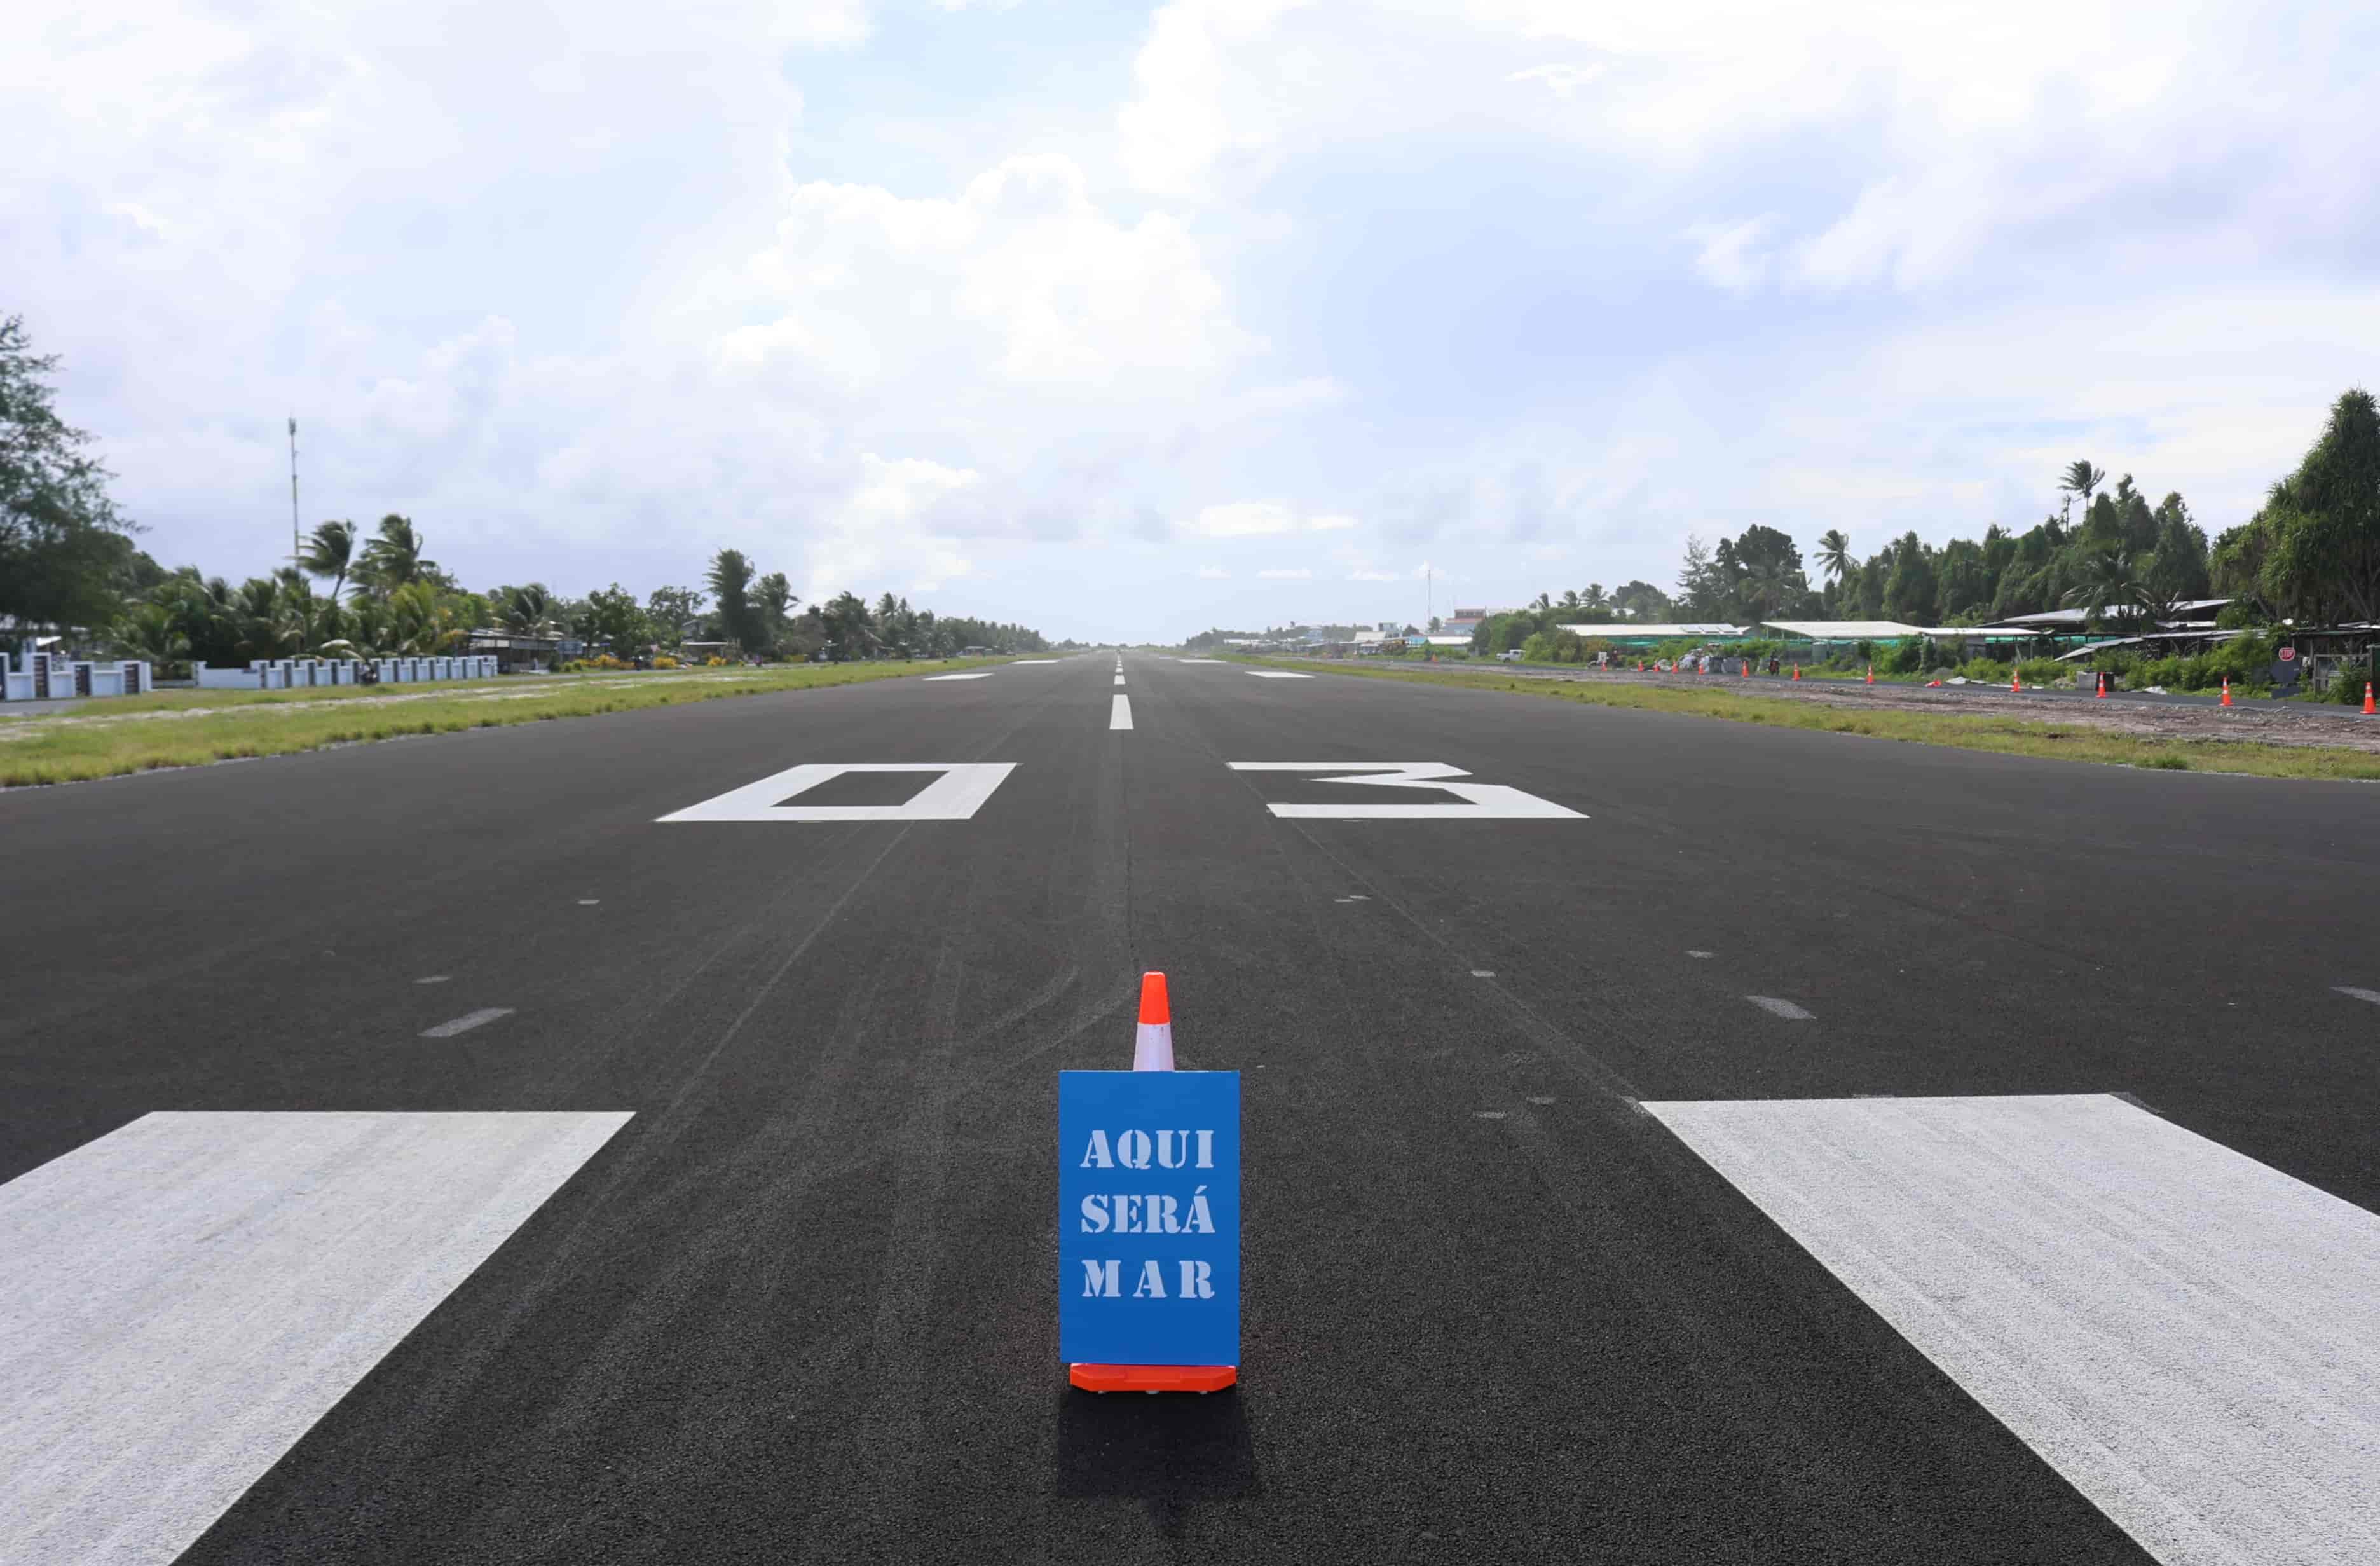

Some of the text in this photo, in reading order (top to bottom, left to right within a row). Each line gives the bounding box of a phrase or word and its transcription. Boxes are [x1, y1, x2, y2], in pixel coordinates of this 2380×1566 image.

[1080, 1129, 1214, 1169] AQUI
[1081, 1185, 1215, 1233] SERÁ
[1082, 1260, 1215, 1298] MAR
